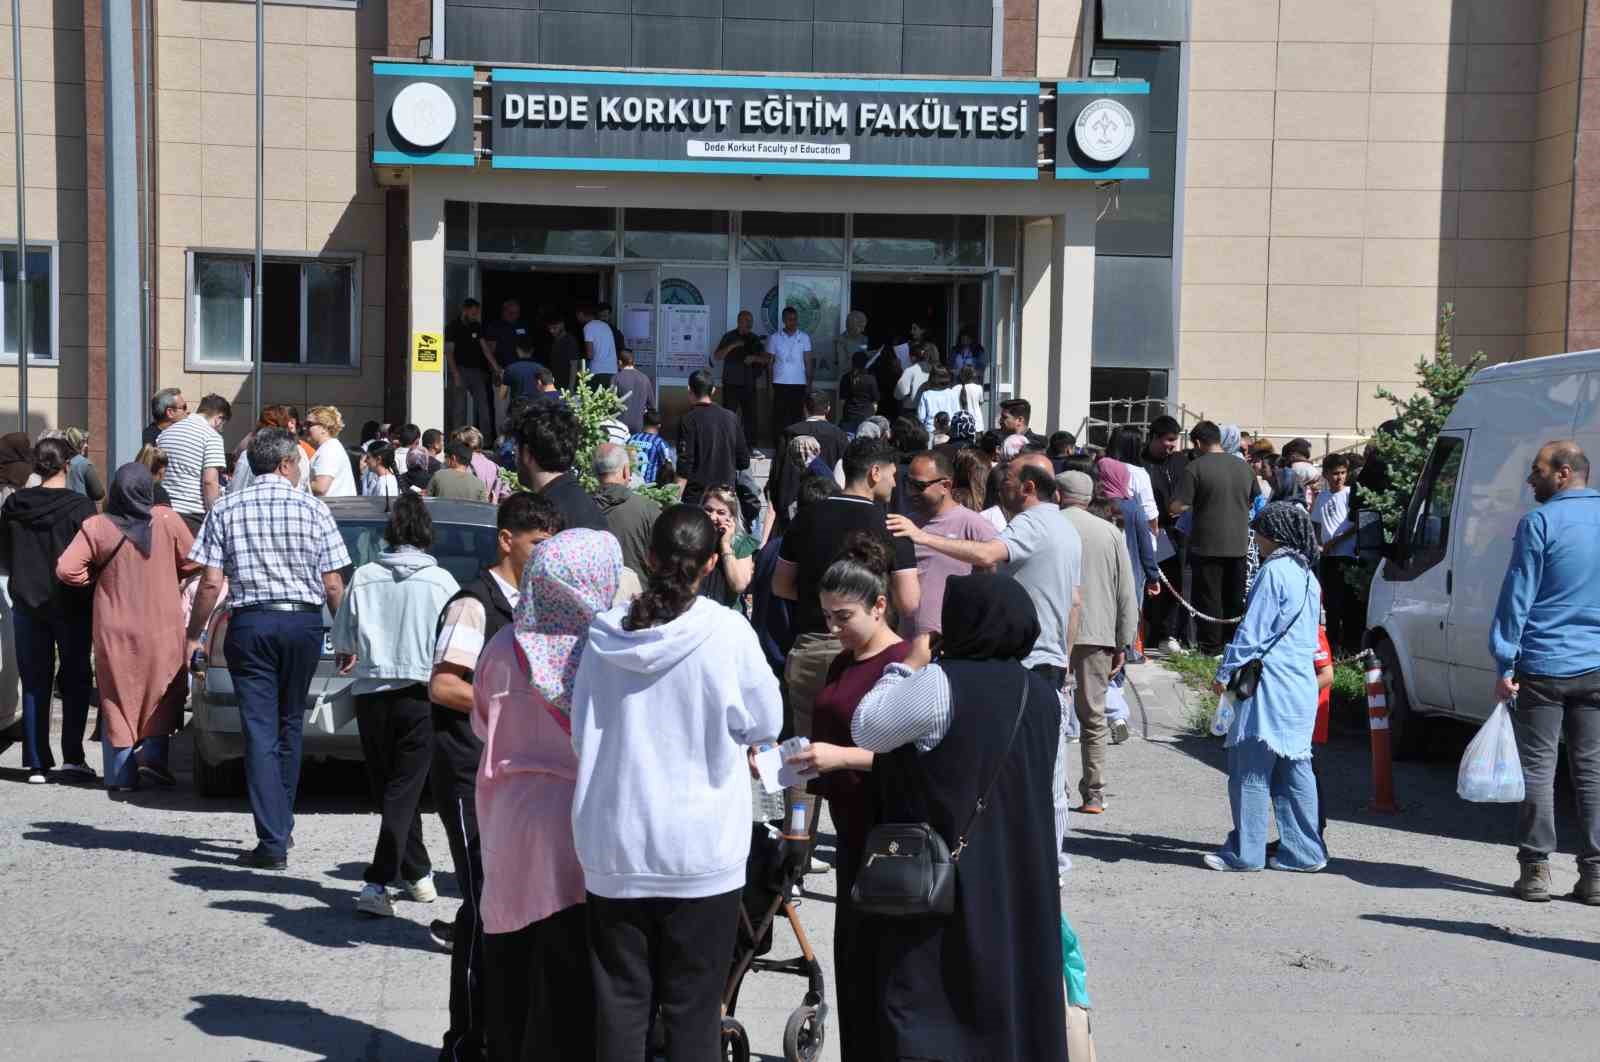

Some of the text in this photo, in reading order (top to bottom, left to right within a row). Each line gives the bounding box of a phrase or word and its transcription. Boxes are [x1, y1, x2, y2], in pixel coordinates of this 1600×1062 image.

[504, 93, 1028, 132] DEDE KORKUT EĞİTİM FAKÜLTESİ
[704, 142, 841, 155] Dede Korkut Faculty of Education
